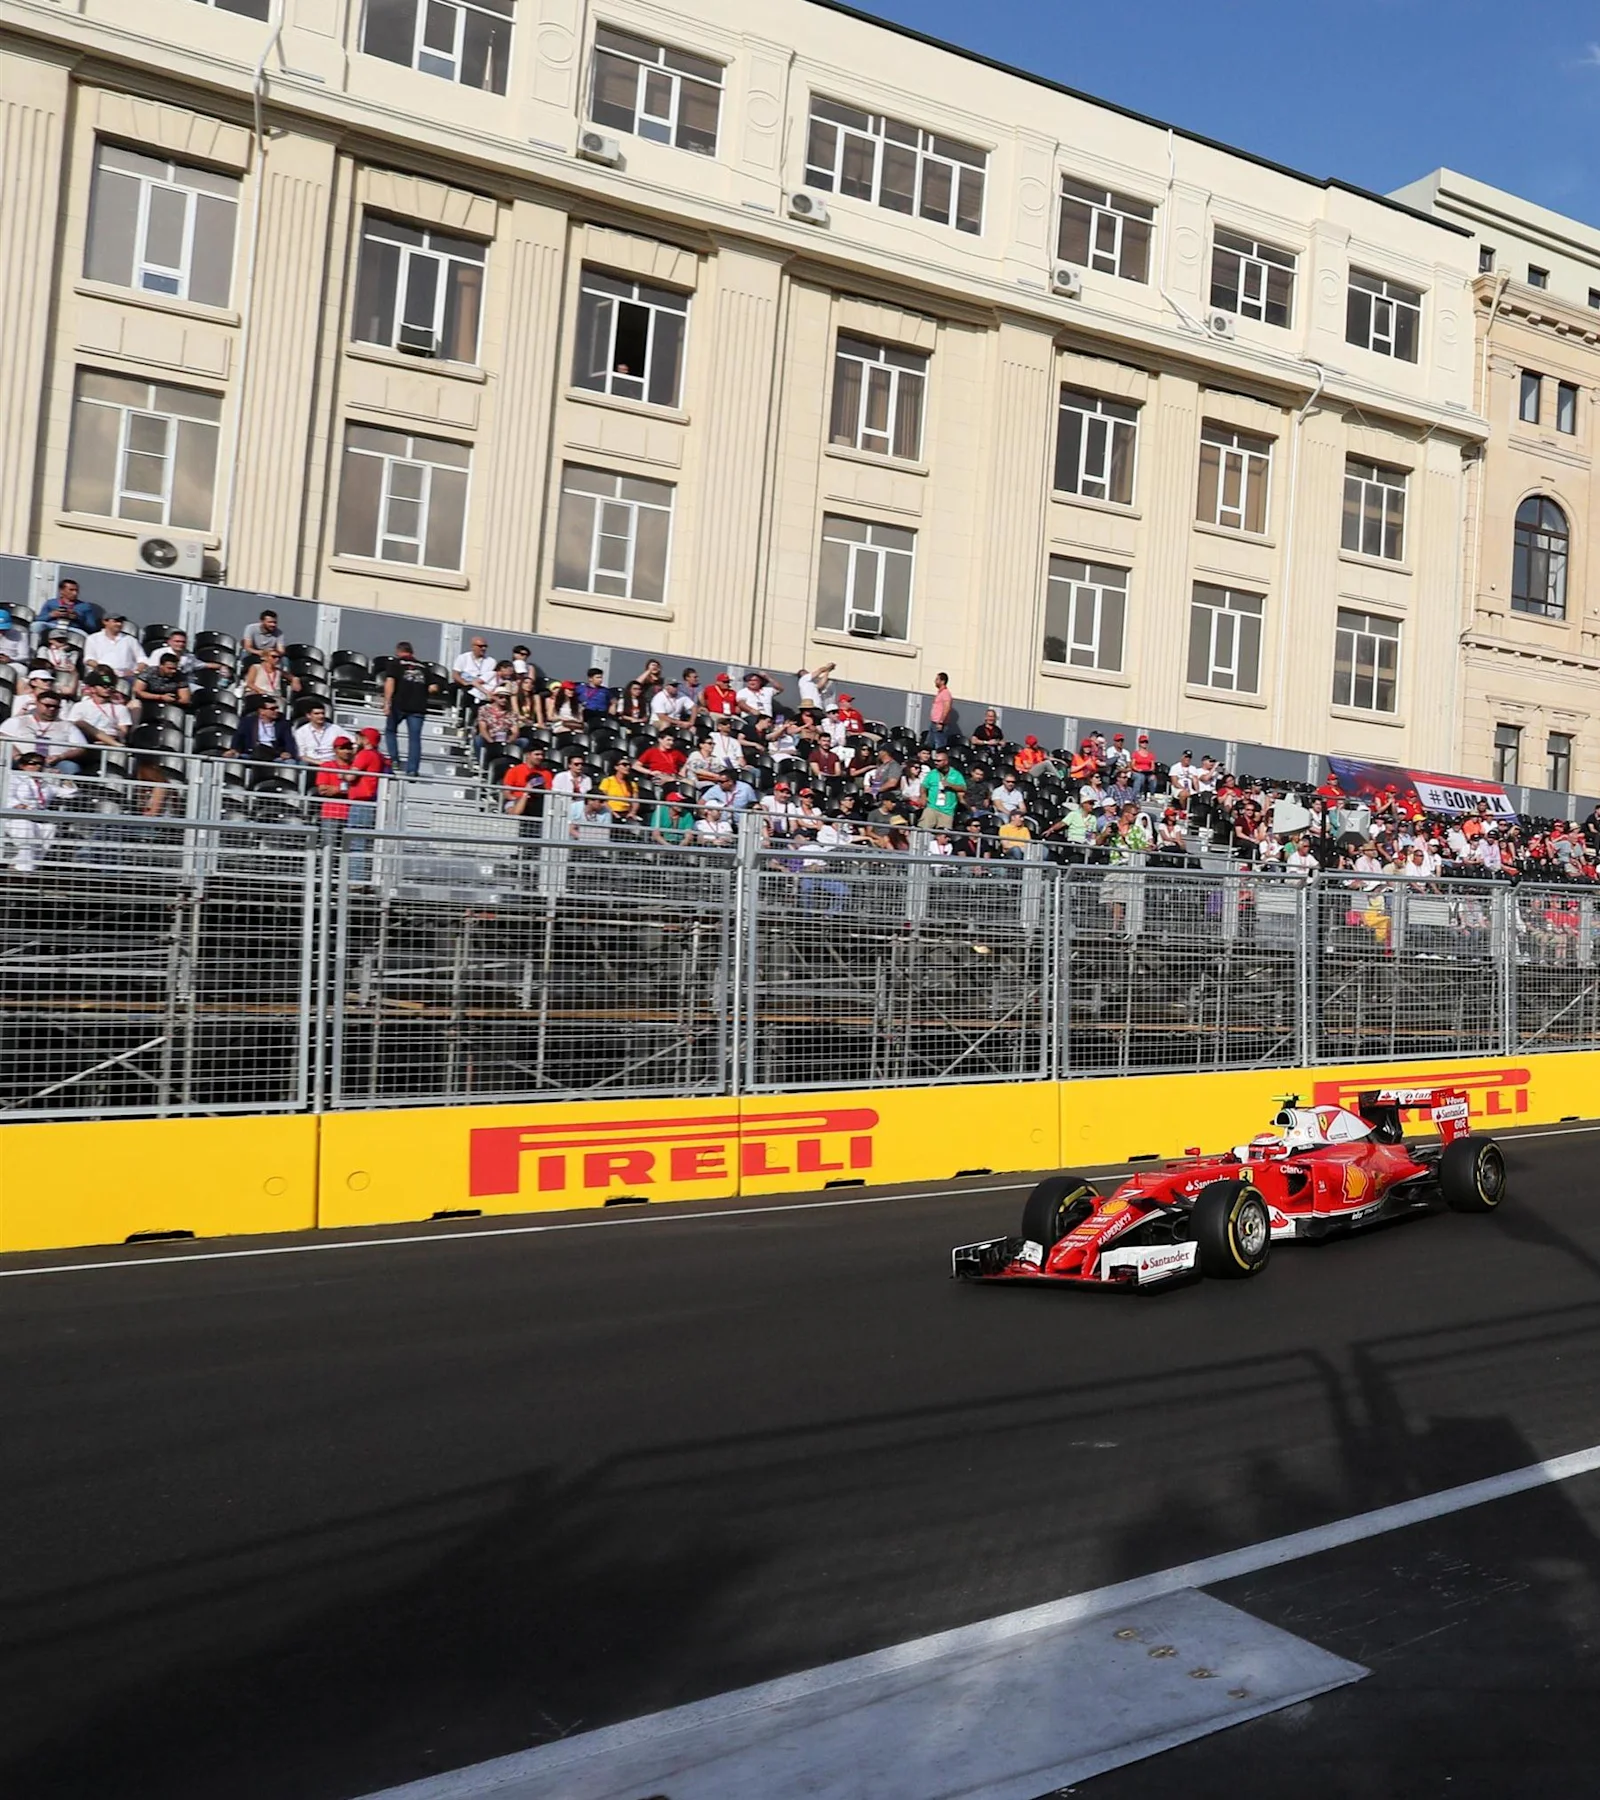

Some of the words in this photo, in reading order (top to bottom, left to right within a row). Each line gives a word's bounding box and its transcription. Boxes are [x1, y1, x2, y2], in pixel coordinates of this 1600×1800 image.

[469, 1108, 879, 1197] PIRELLI
[1280, 1165, 1303, 1174] Claro
[1149, 1250, 1190, 1268] Santander
